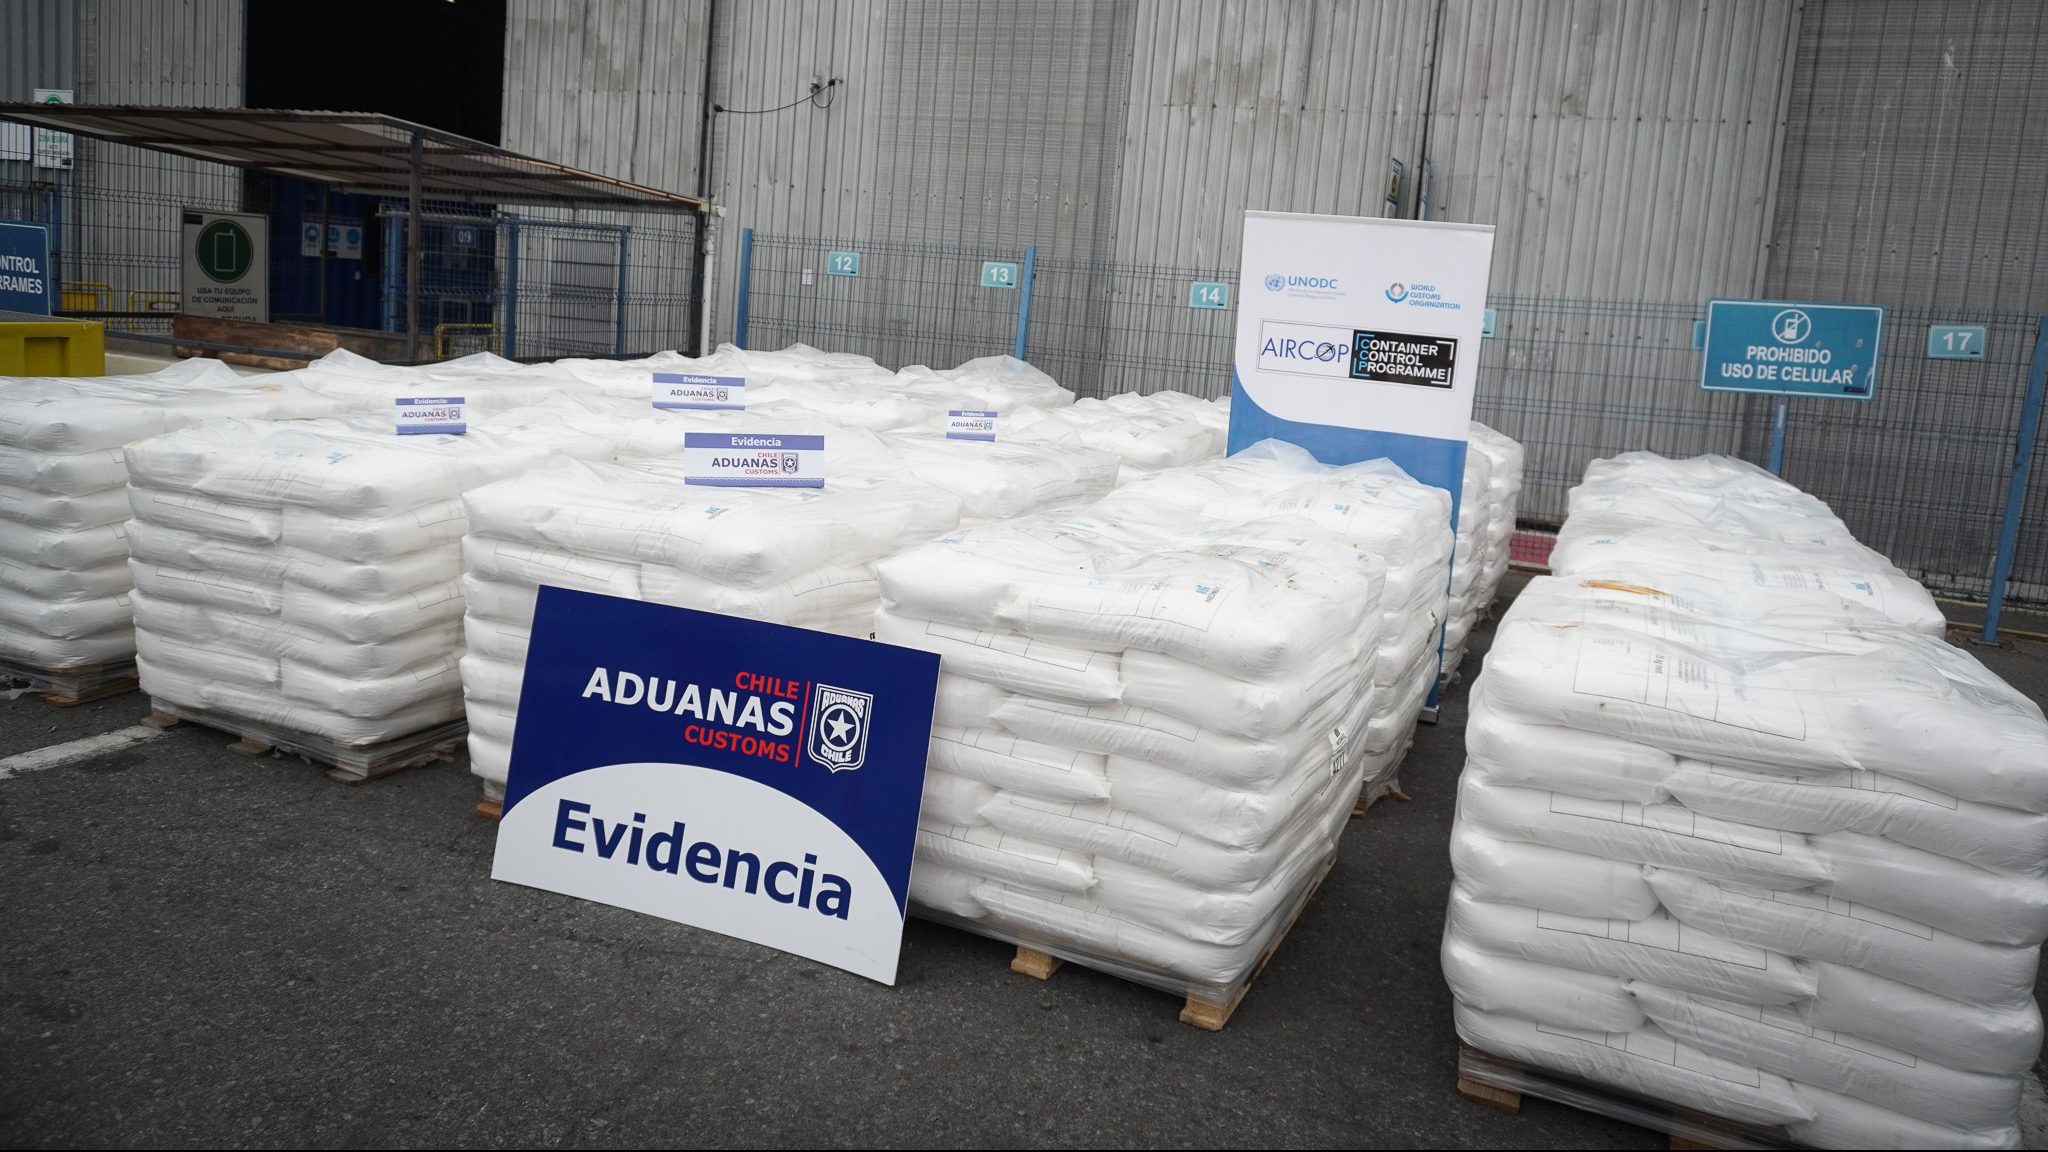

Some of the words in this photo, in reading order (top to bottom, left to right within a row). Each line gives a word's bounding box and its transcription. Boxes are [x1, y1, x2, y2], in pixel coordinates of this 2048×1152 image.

[458, 230, 472, 243] 09
[0, 254, 39, 273] NTROL
[835, 256, 852, 270] 12
[990, 268, 1009, 282] 13
[1288, 276, 1338, 289] UNODC
[1199, 287, 1220, 303] 14
[1410, 292, 1441, 300] CUSTOMS
[1411, 284, 1436, 292] WORLD
[203, 296, 258, 304] COMUNICACIÓN
[1409, 300, 1461, 310] ORGANIZATION
[1361, 339, 1439, 356] CONTAINER
[1943, 332, 1973, 351] 17
[1261, 337, 1349, 363] AIRCOP
[1360, 350, 1423, 366] CONTROL
[1746, 346, 1831, 364] PROHIBIDO
[1358, 361, 1446, 380] PROGRAMME
[1721, 363, 1754, 379] USO
[1756, 366, 1777, 380] DE
[1781, 366, 1853, 384] CELULAR
[683, 376, 717, 384] Evidencia
[670, 389, 715, 397] ADUANAS
[731, 437, 782, 447] Evidencia
[712, 457, 778, 468] ADUANAS
[735, 671, 800, 699] CHILE
[582, 666, 796, 736] ADUANAS
[821, 691, 865, 719] ADUANAS
[684, 725, 790, 763] CUSTOMS
[821, 744, 852, 763] CHILE
[552, 798, 852, 921] Evidencia
